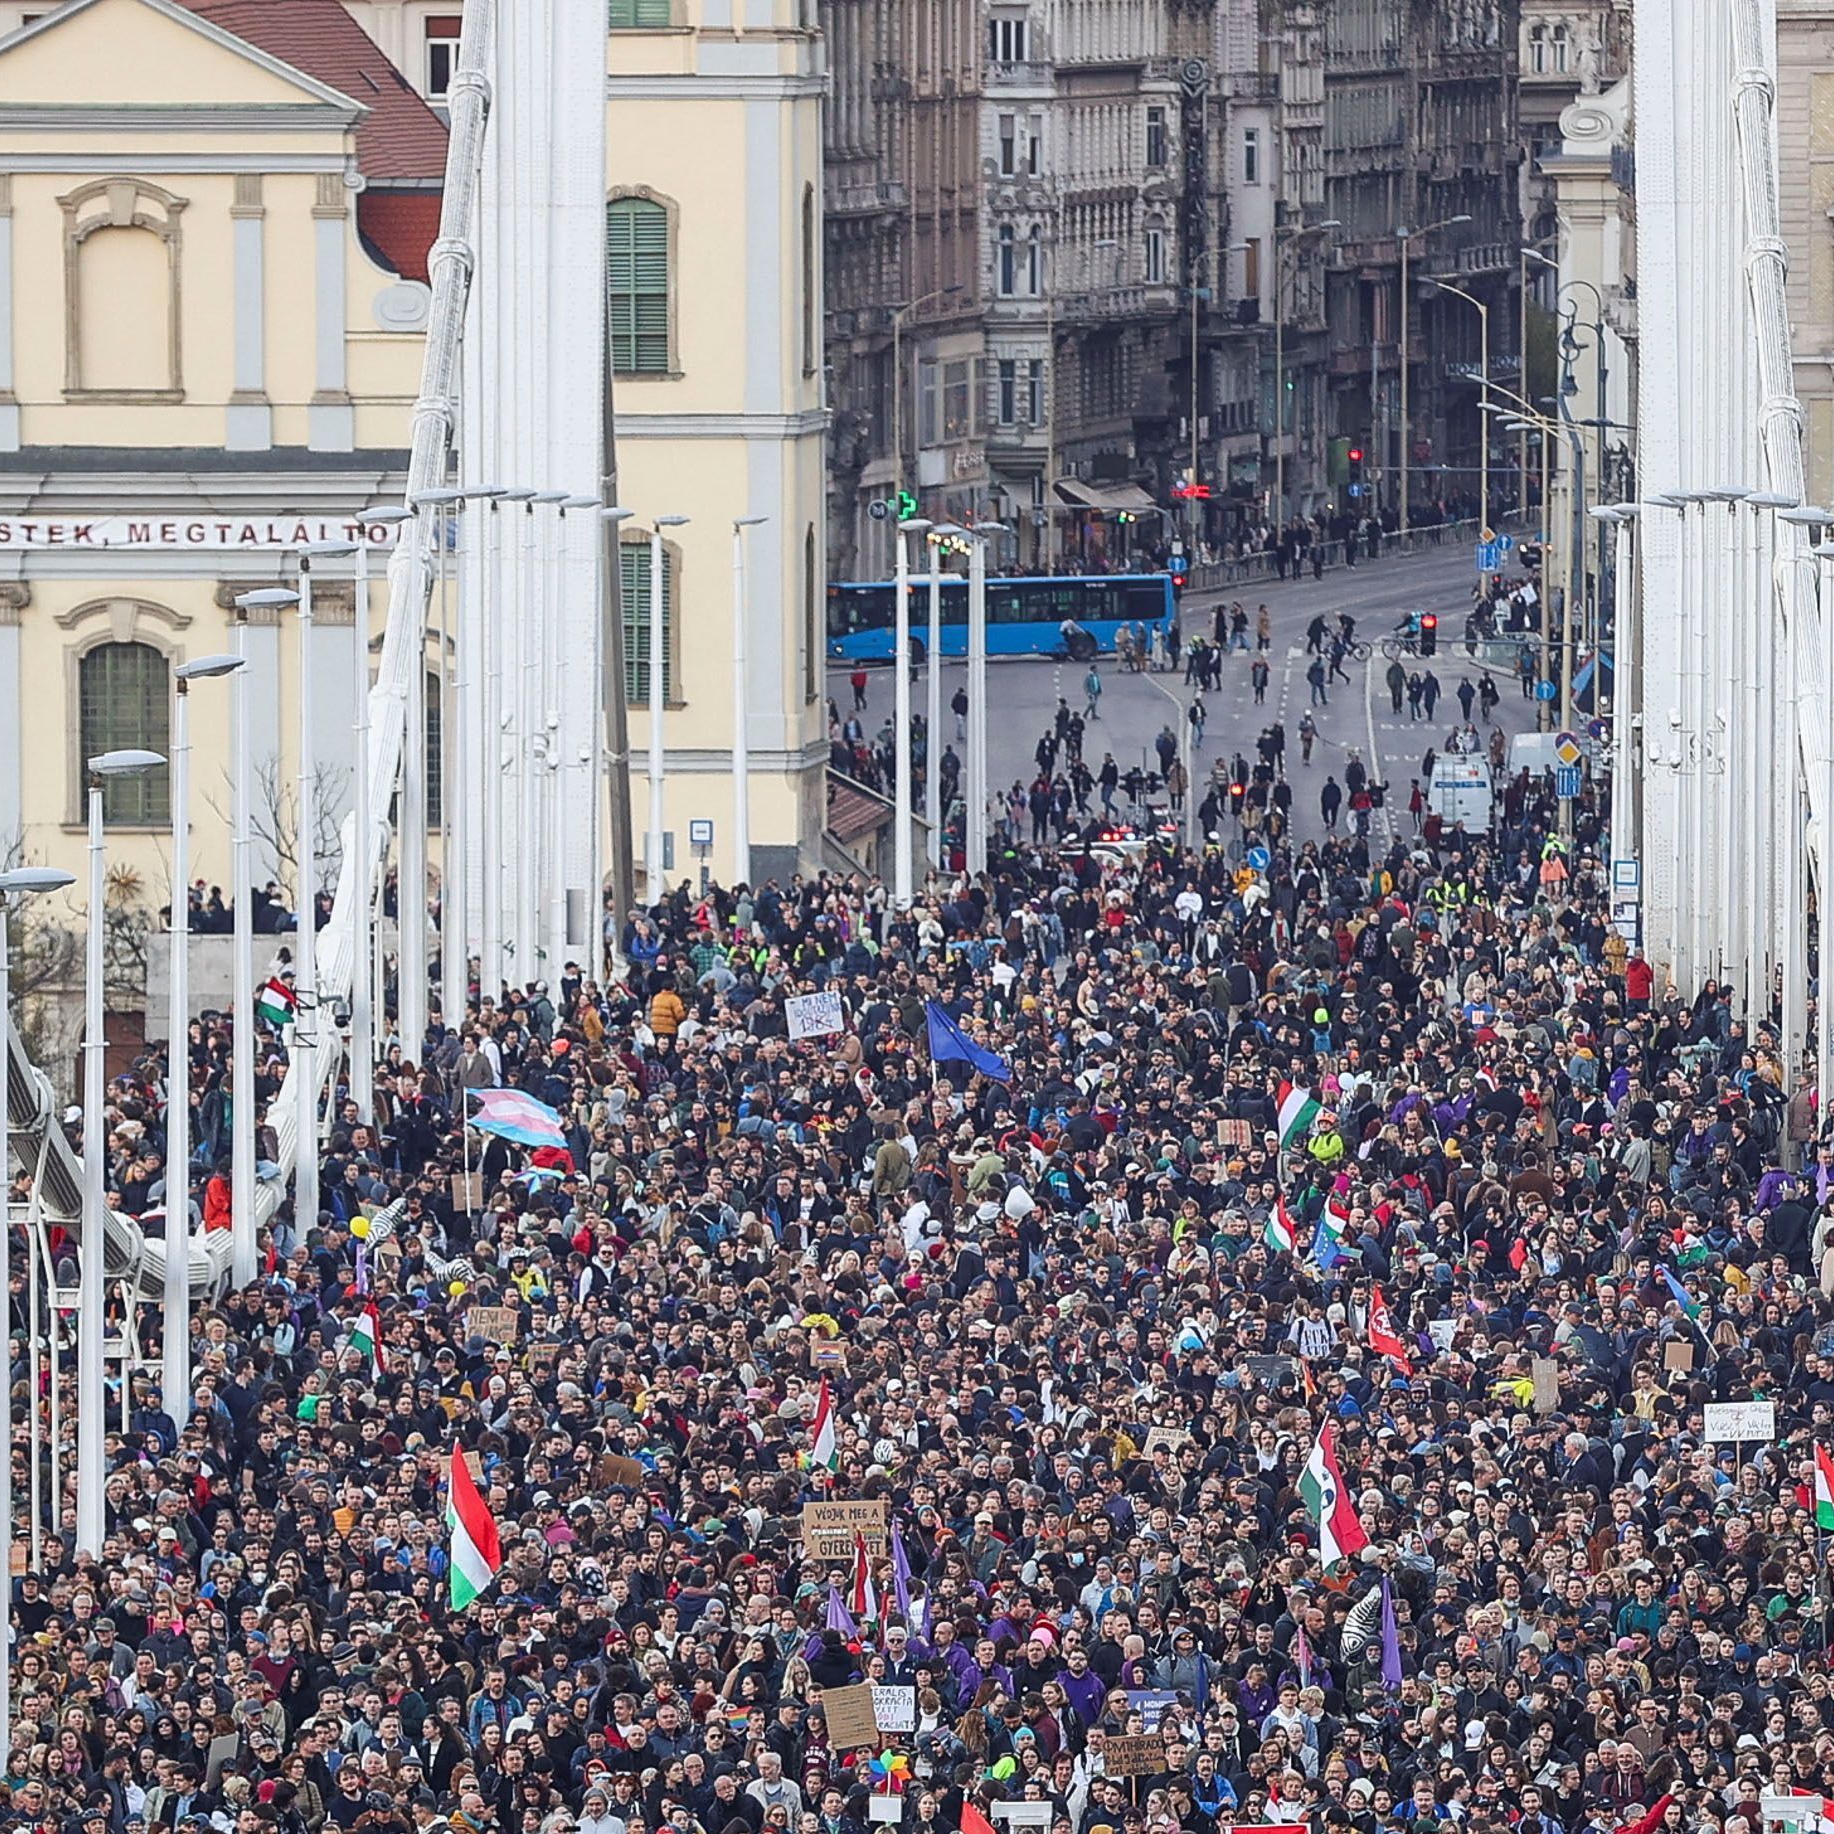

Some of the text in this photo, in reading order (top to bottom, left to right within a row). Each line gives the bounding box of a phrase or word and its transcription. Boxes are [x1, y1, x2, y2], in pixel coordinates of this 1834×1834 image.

[128, 517, 403, 544] MEGTALÁLTO
[849, 1508, 868, 1520] MEG
[872, 1508, 879, 1519] A
